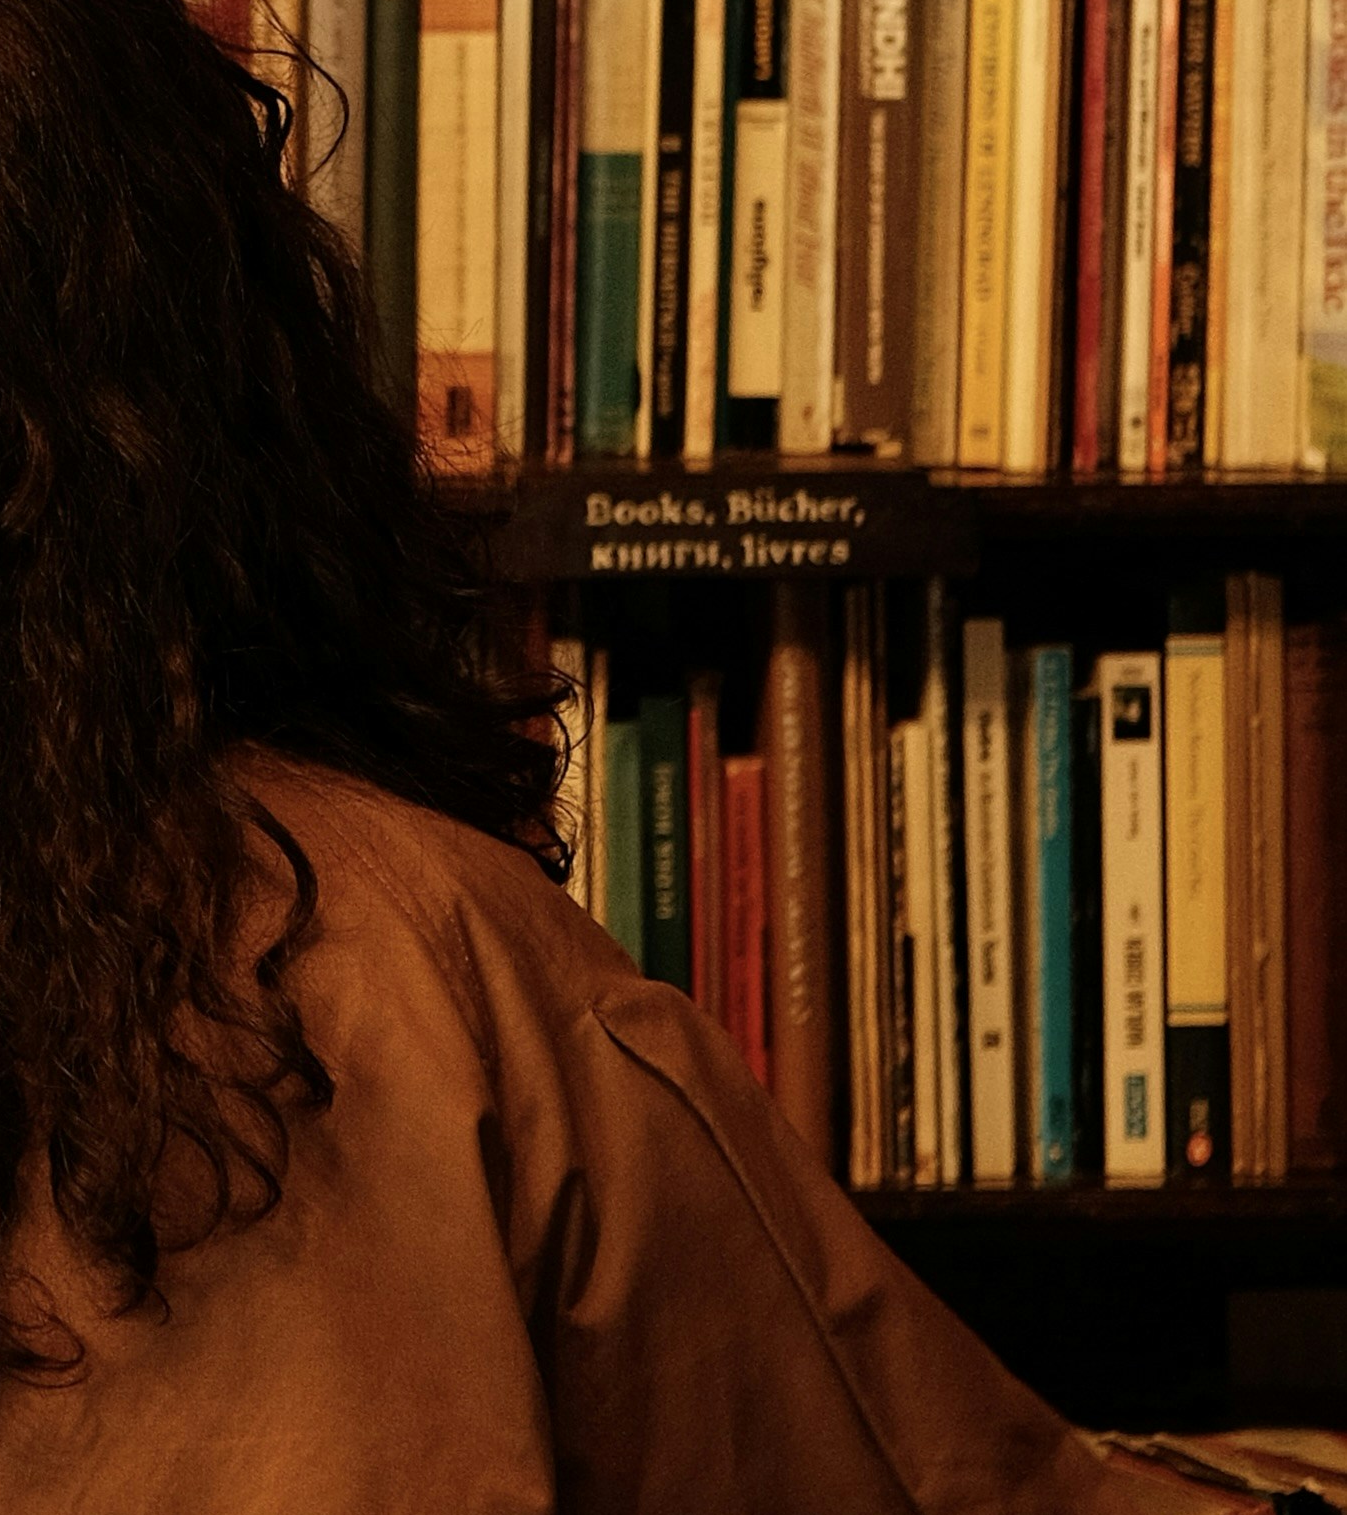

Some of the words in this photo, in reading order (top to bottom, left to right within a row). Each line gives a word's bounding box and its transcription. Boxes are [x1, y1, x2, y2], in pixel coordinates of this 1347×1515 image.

[585, 490, 716, 528] Books,
[725, 485, 867, 529] Bücher,
[741, 532, 852, 566] livres
